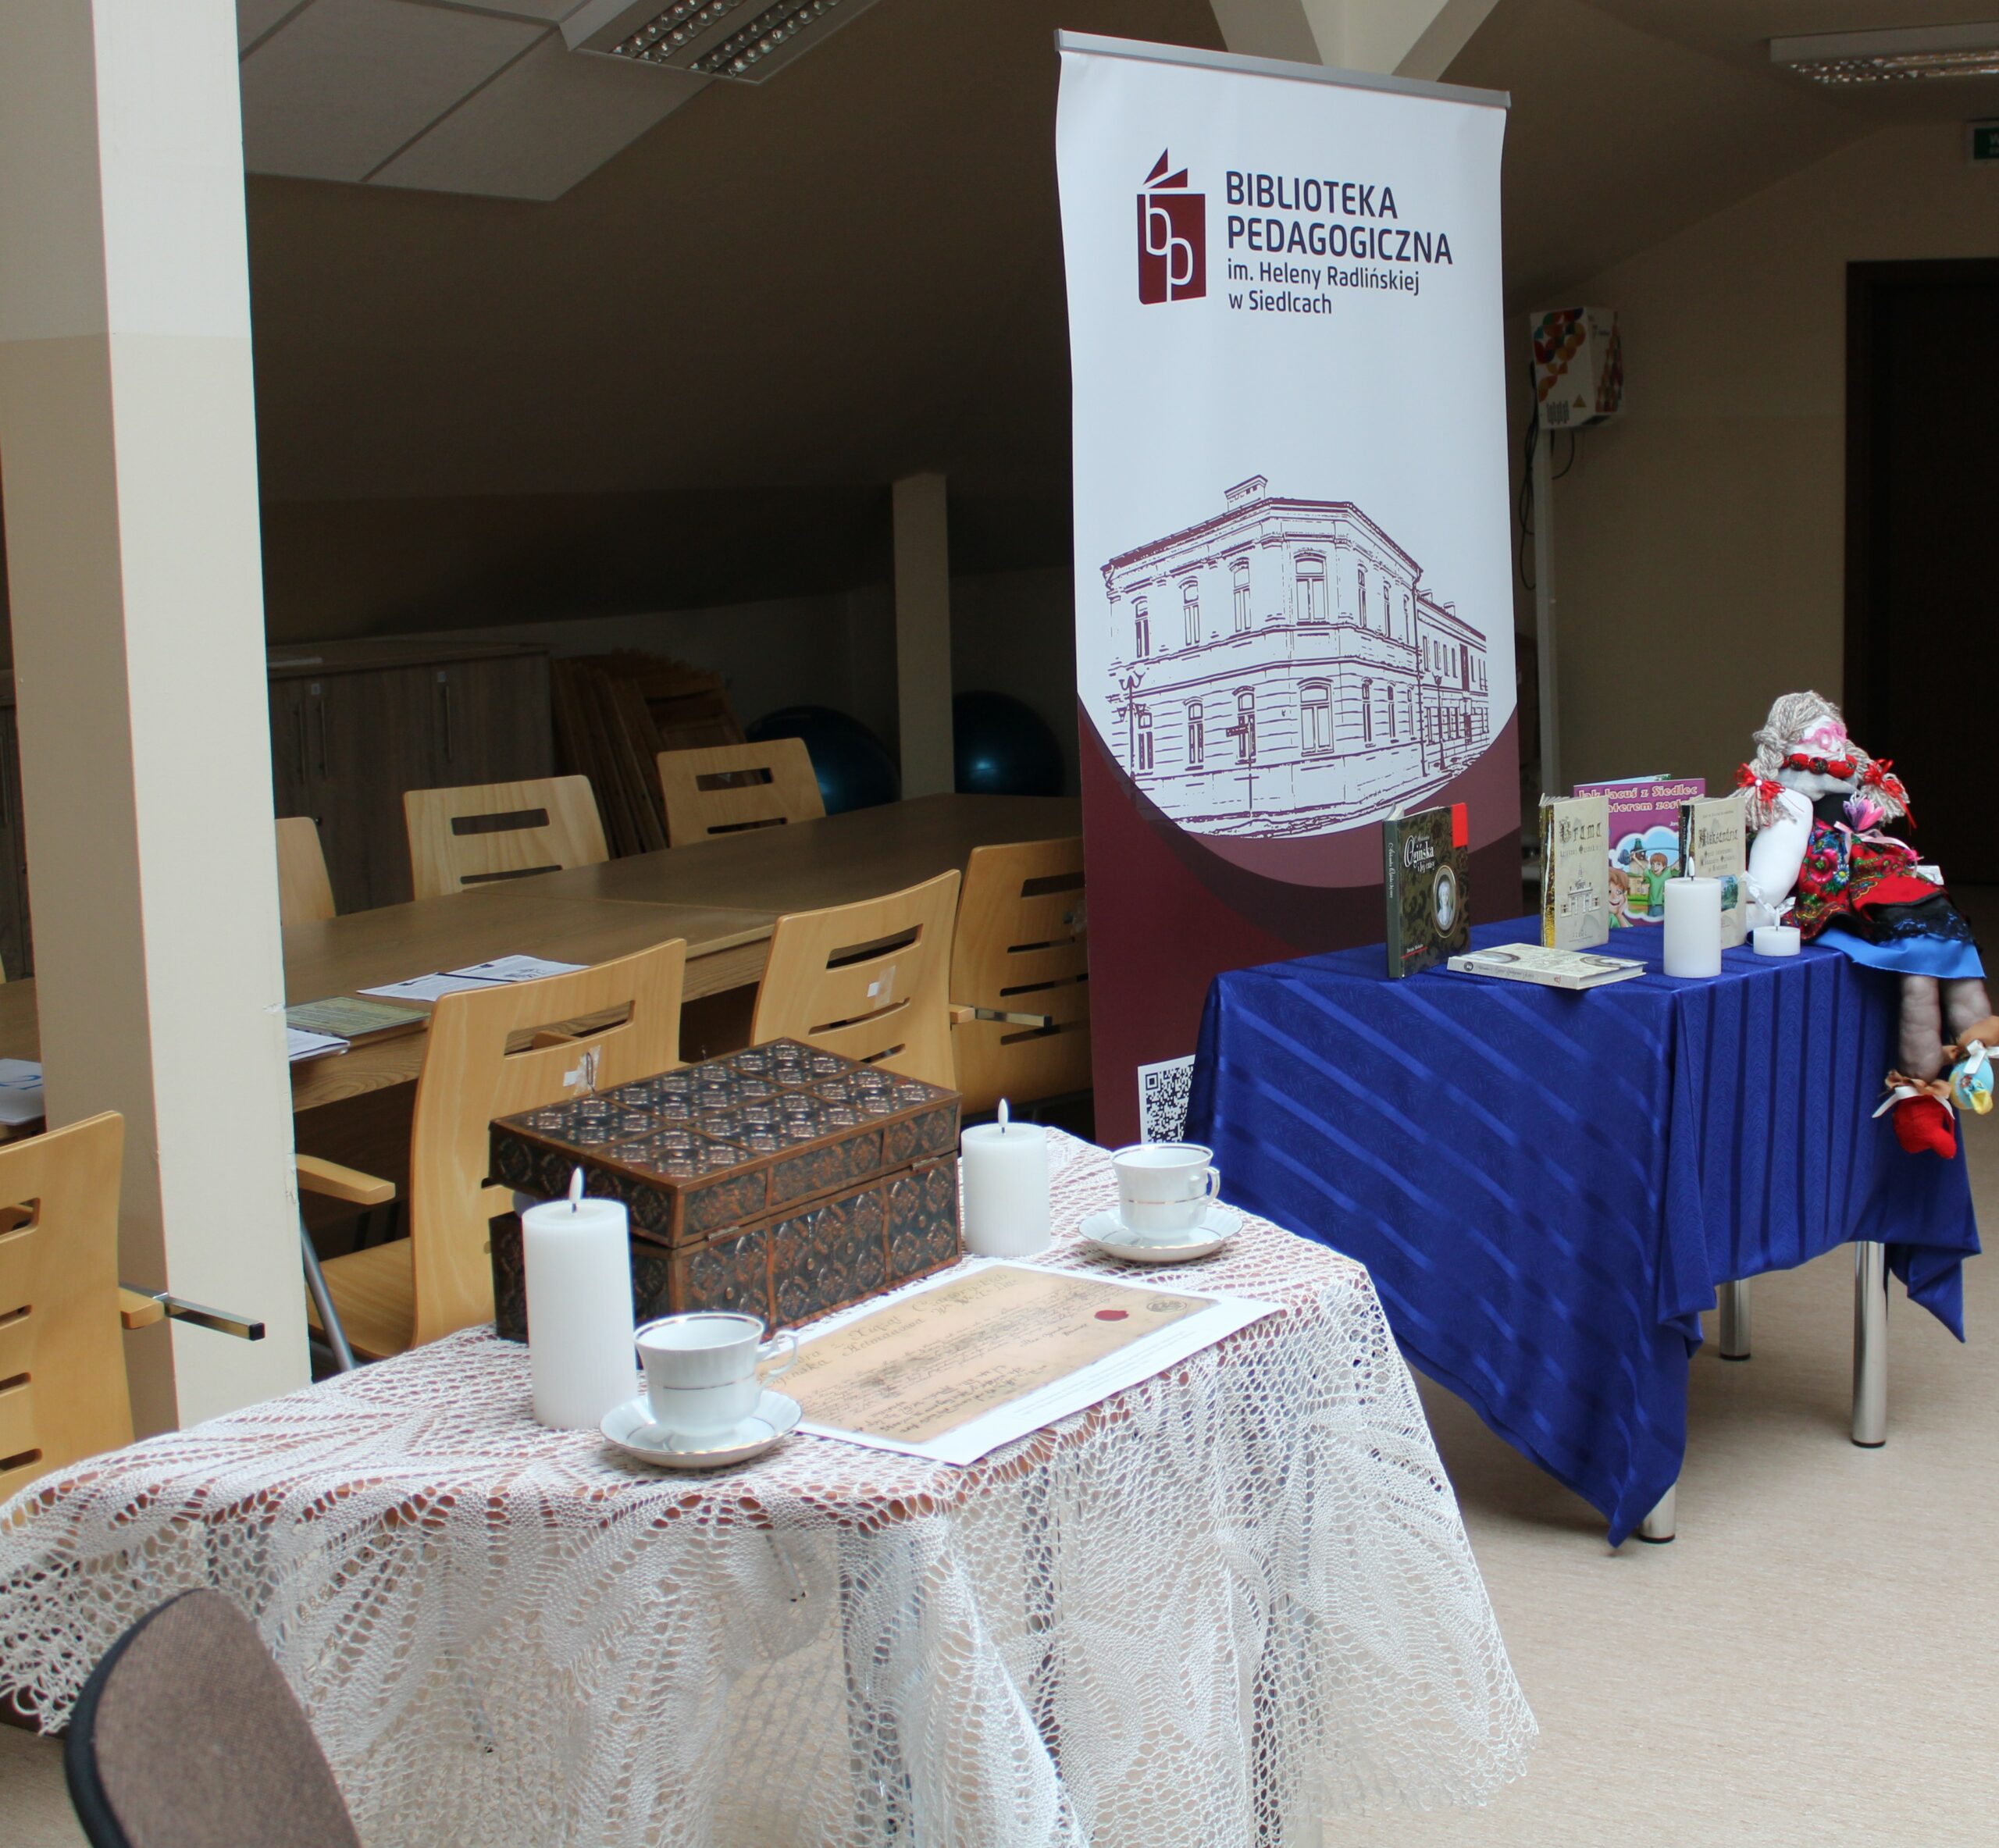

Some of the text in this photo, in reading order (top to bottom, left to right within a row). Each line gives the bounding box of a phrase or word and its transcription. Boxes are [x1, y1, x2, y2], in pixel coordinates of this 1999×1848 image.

[1226, 170, 1399, 219] BIBLIOTEKA
[1228, 215, 1453, 265] PEDAGOGICZNA
[1228, 258, 1420, 296] im. Heleny Radlińskiej
[1228, 289, 1332, 315] w Siedlcach
[1640, 789, 1649, 798] z
[1652, 784, 1698, 797] Siedlec
[1608, 803, 1653, 813] aterem
